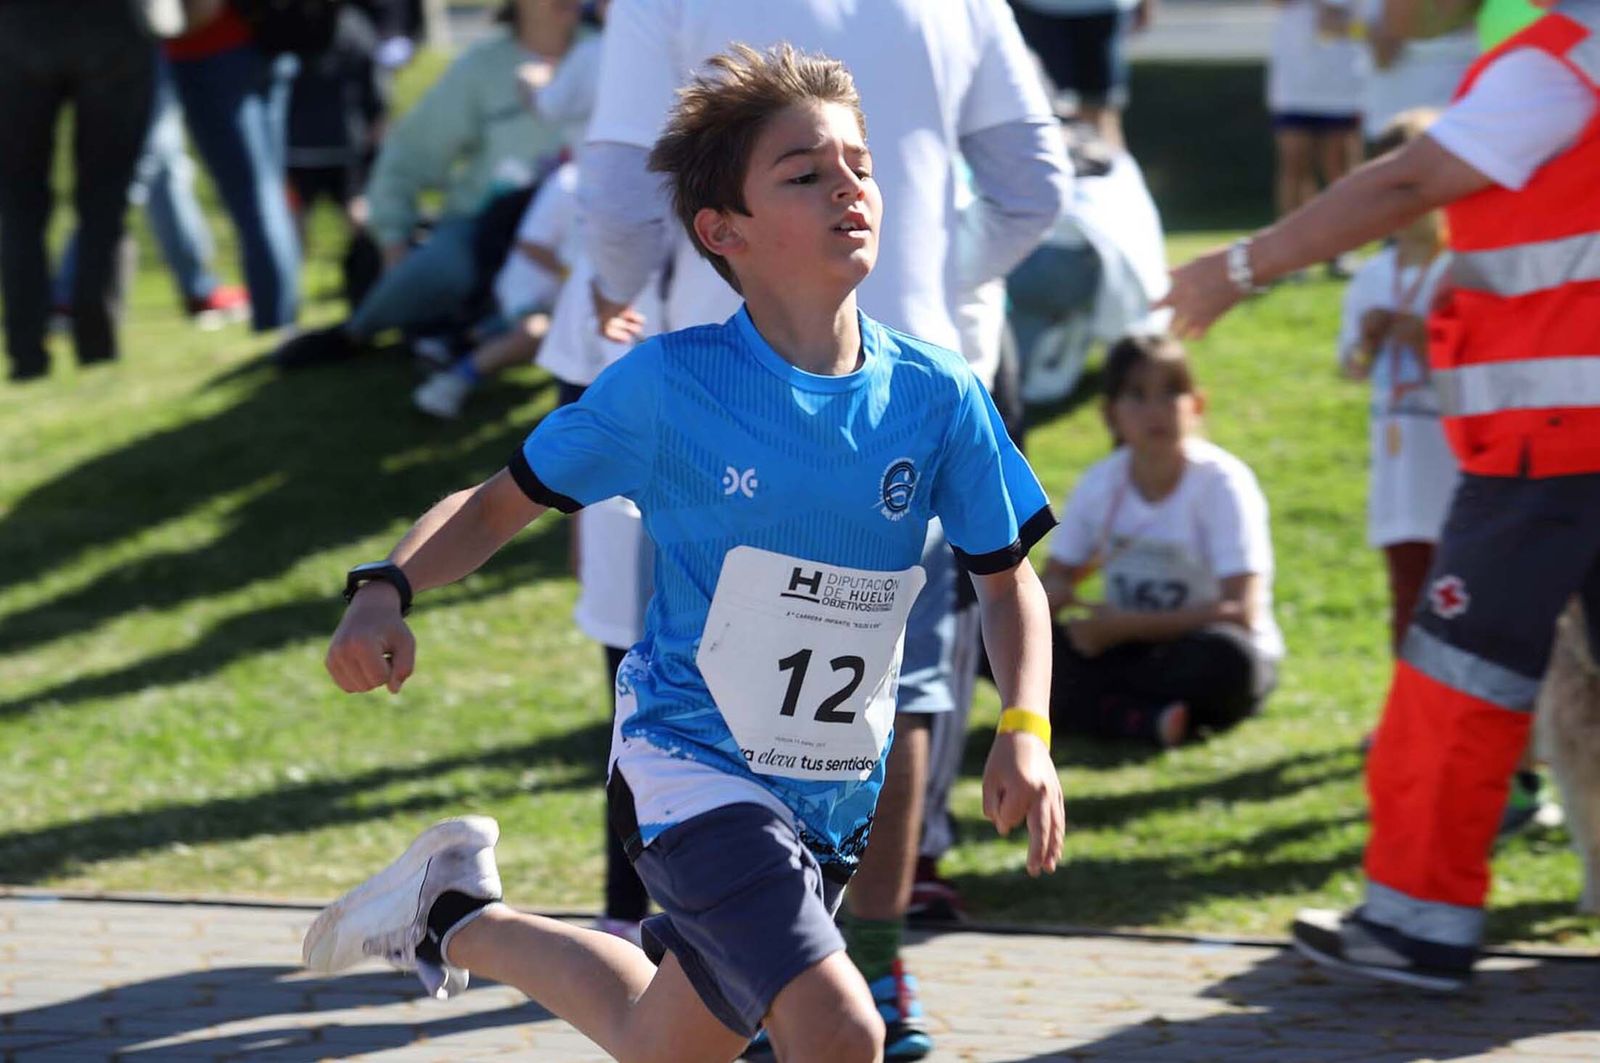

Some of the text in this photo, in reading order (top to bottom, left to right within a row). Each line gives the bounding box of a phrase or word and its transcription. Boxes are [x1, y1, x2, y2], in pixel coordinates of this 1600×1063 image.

[788, 567, 823, 595] H
[821, 597, 872, 612] OBJETIVOS
[823, 586, 895, 603] DE HUELVA
[778, 648, 865, 724] 12
[757, 748, 798, 768] eleva
[800, 755, 824, 771] tus
[825, 756, 877, 771] sentido
